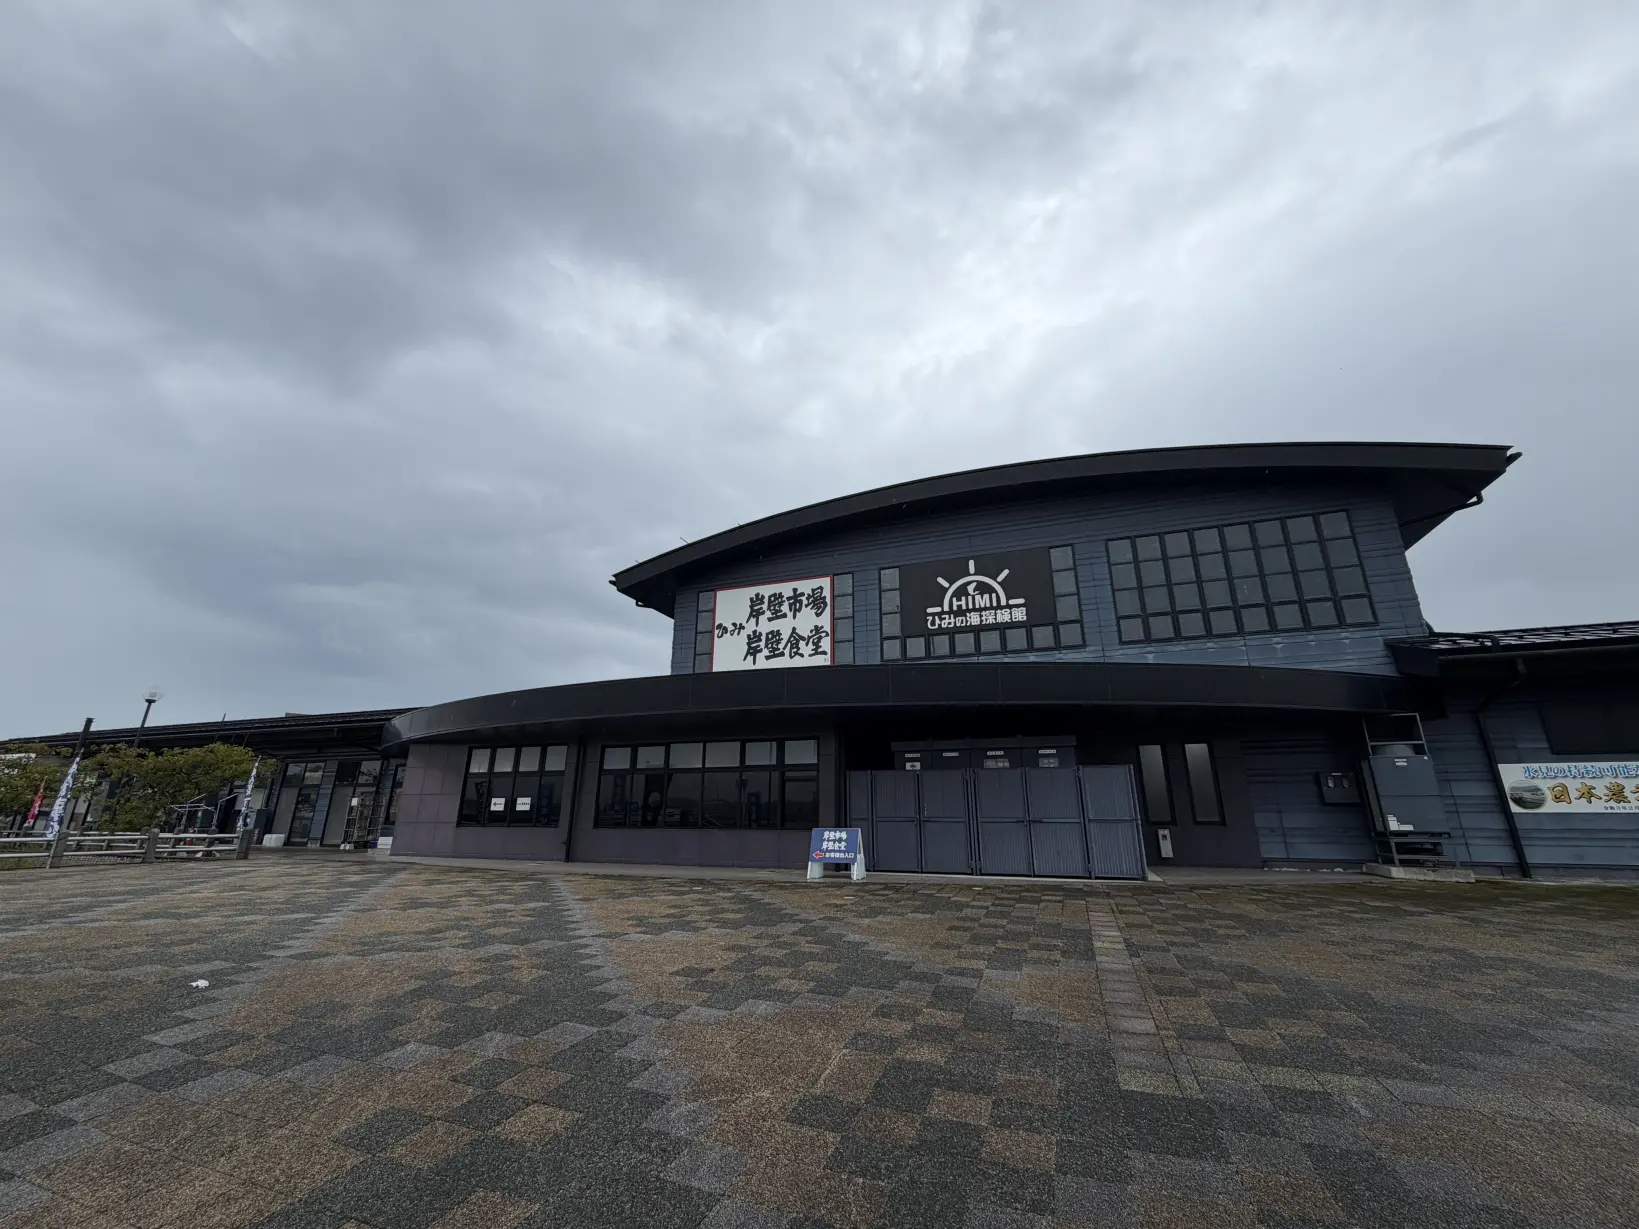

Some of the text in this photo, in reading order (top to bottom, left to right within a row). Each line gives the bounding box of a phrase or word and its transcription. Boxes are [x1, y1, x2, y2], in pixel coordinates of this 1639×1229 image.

[746, 585, 828, 628] 岸壁市場
[952, 593, 998, 611] HIMI
[926, 606, 1027, 629] ひみの海探検館
[715, 622, 746, 639] ひみ
[742, 624, 830, 666] 岸壁食堂
